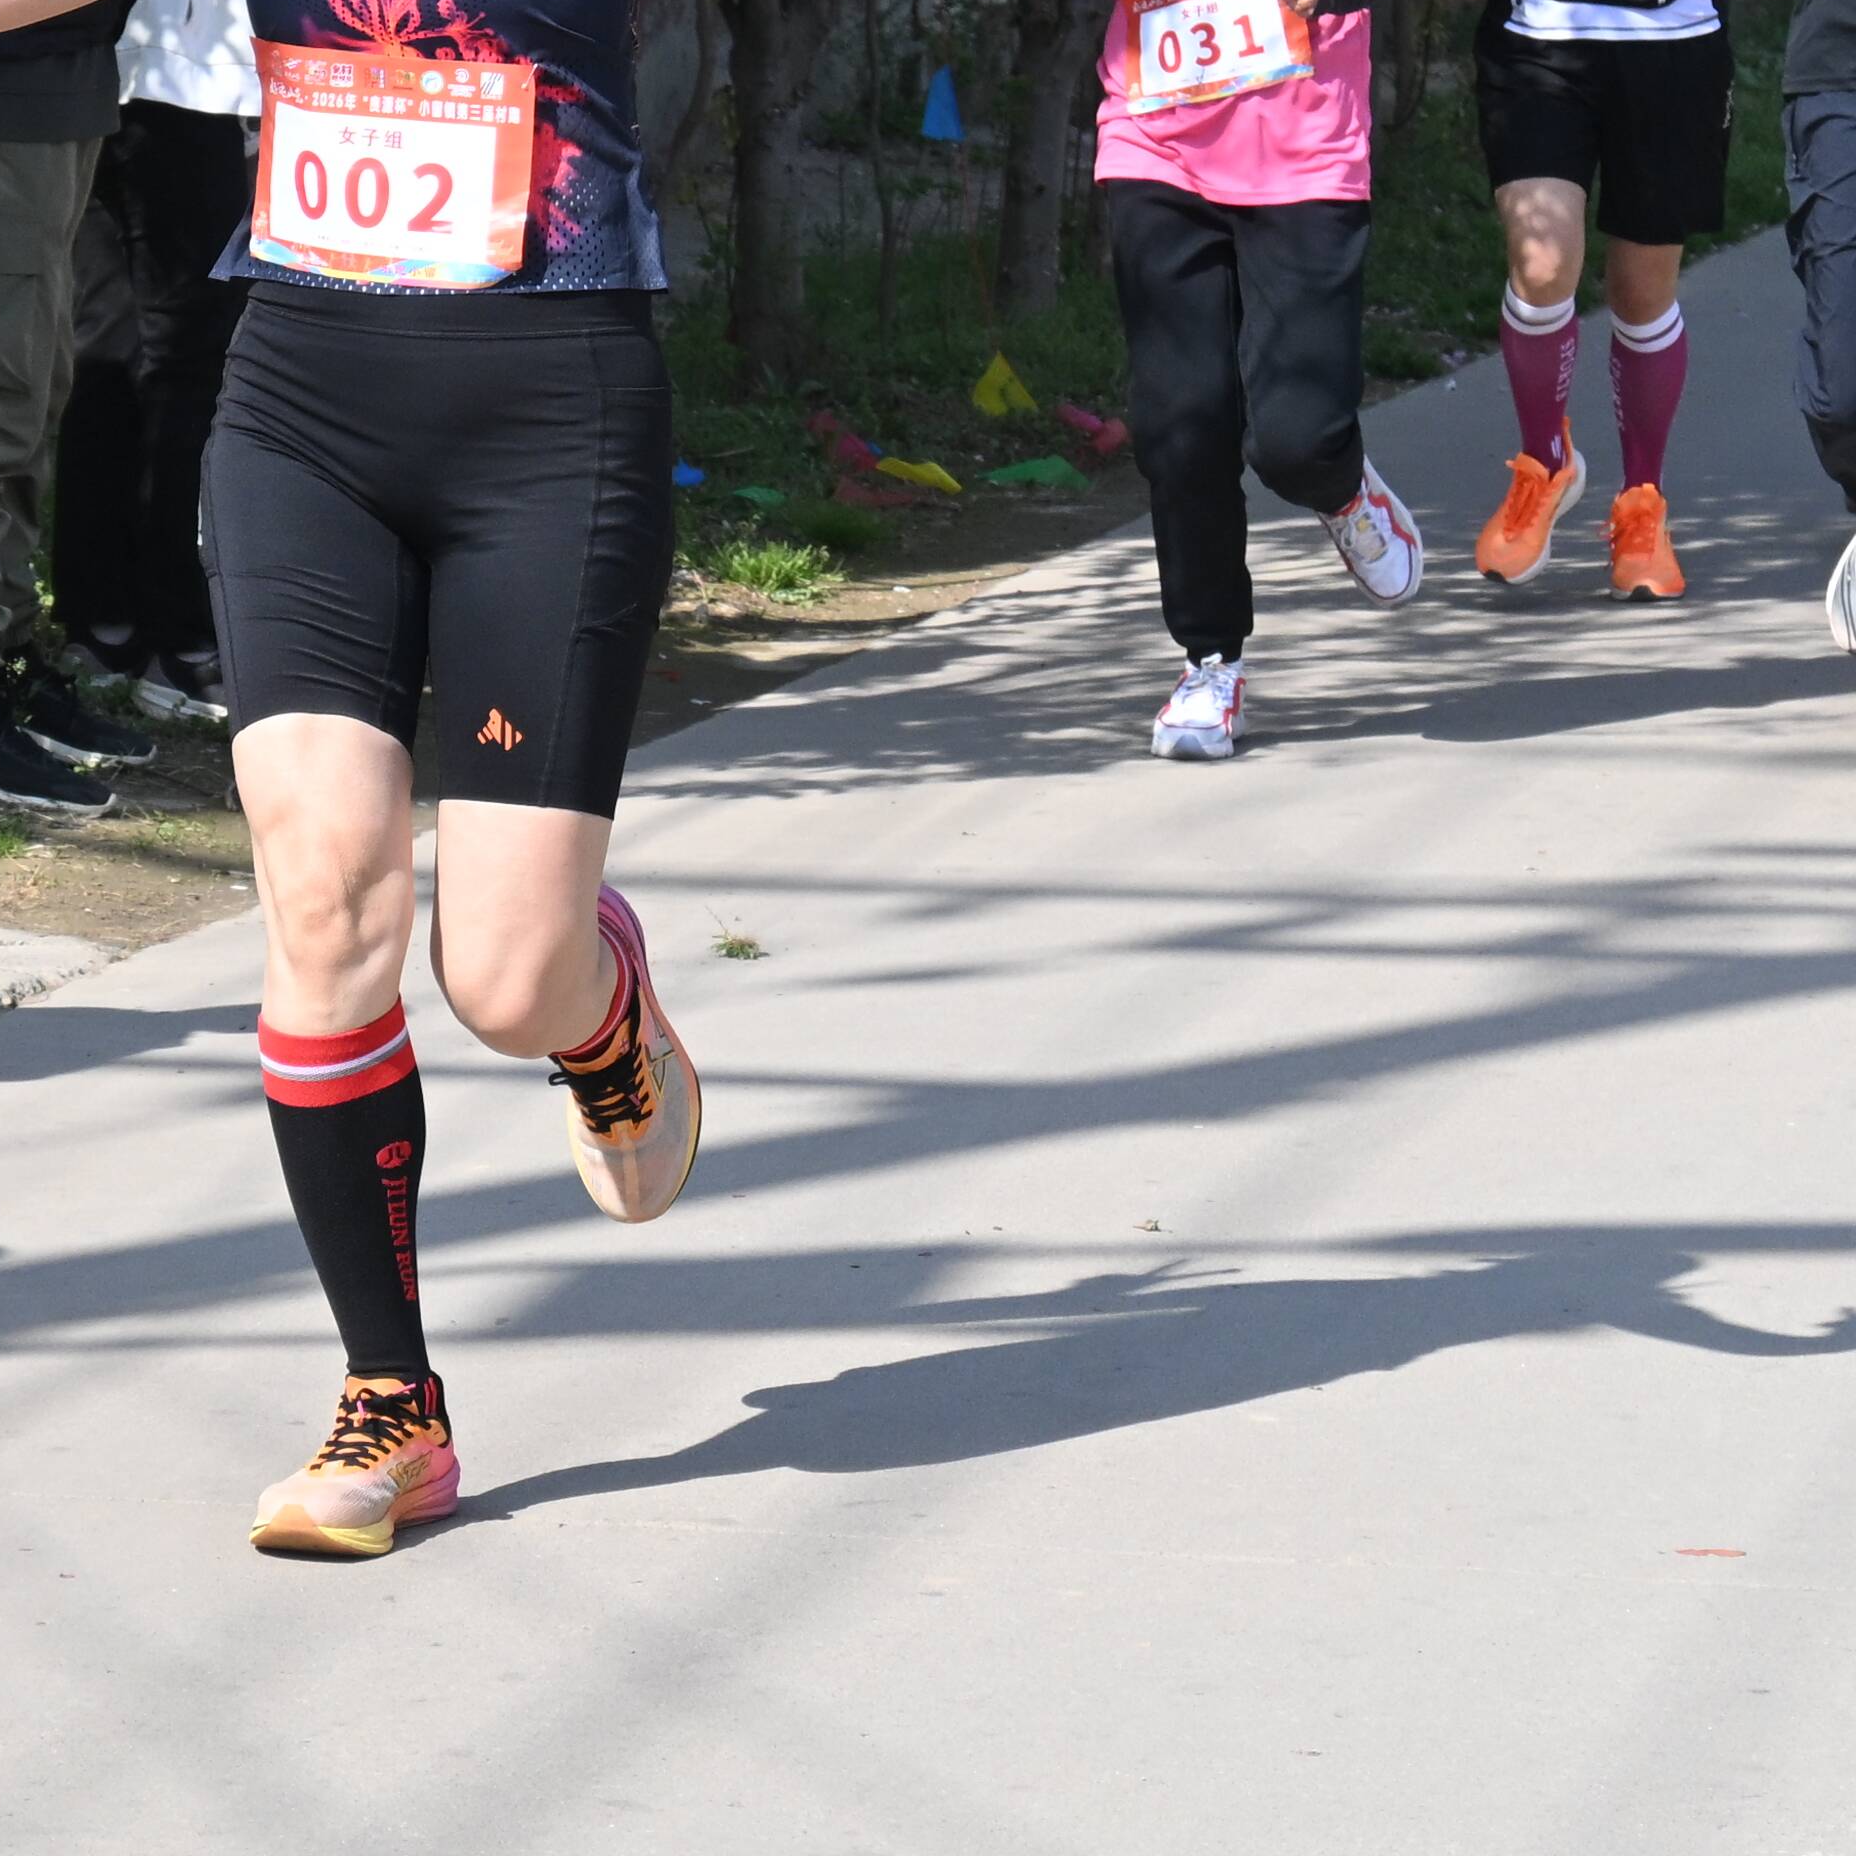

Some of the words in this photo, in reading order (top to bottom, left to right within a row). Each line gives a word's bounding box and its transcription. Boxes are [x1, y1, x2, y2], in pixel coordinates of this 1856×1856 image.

[1157, 14, 1265, 74] 031
[338, 127, 404, 150] 女子组
[294, 150, 454, 235] 002
[395, 1249, 418, 1302] RUN
